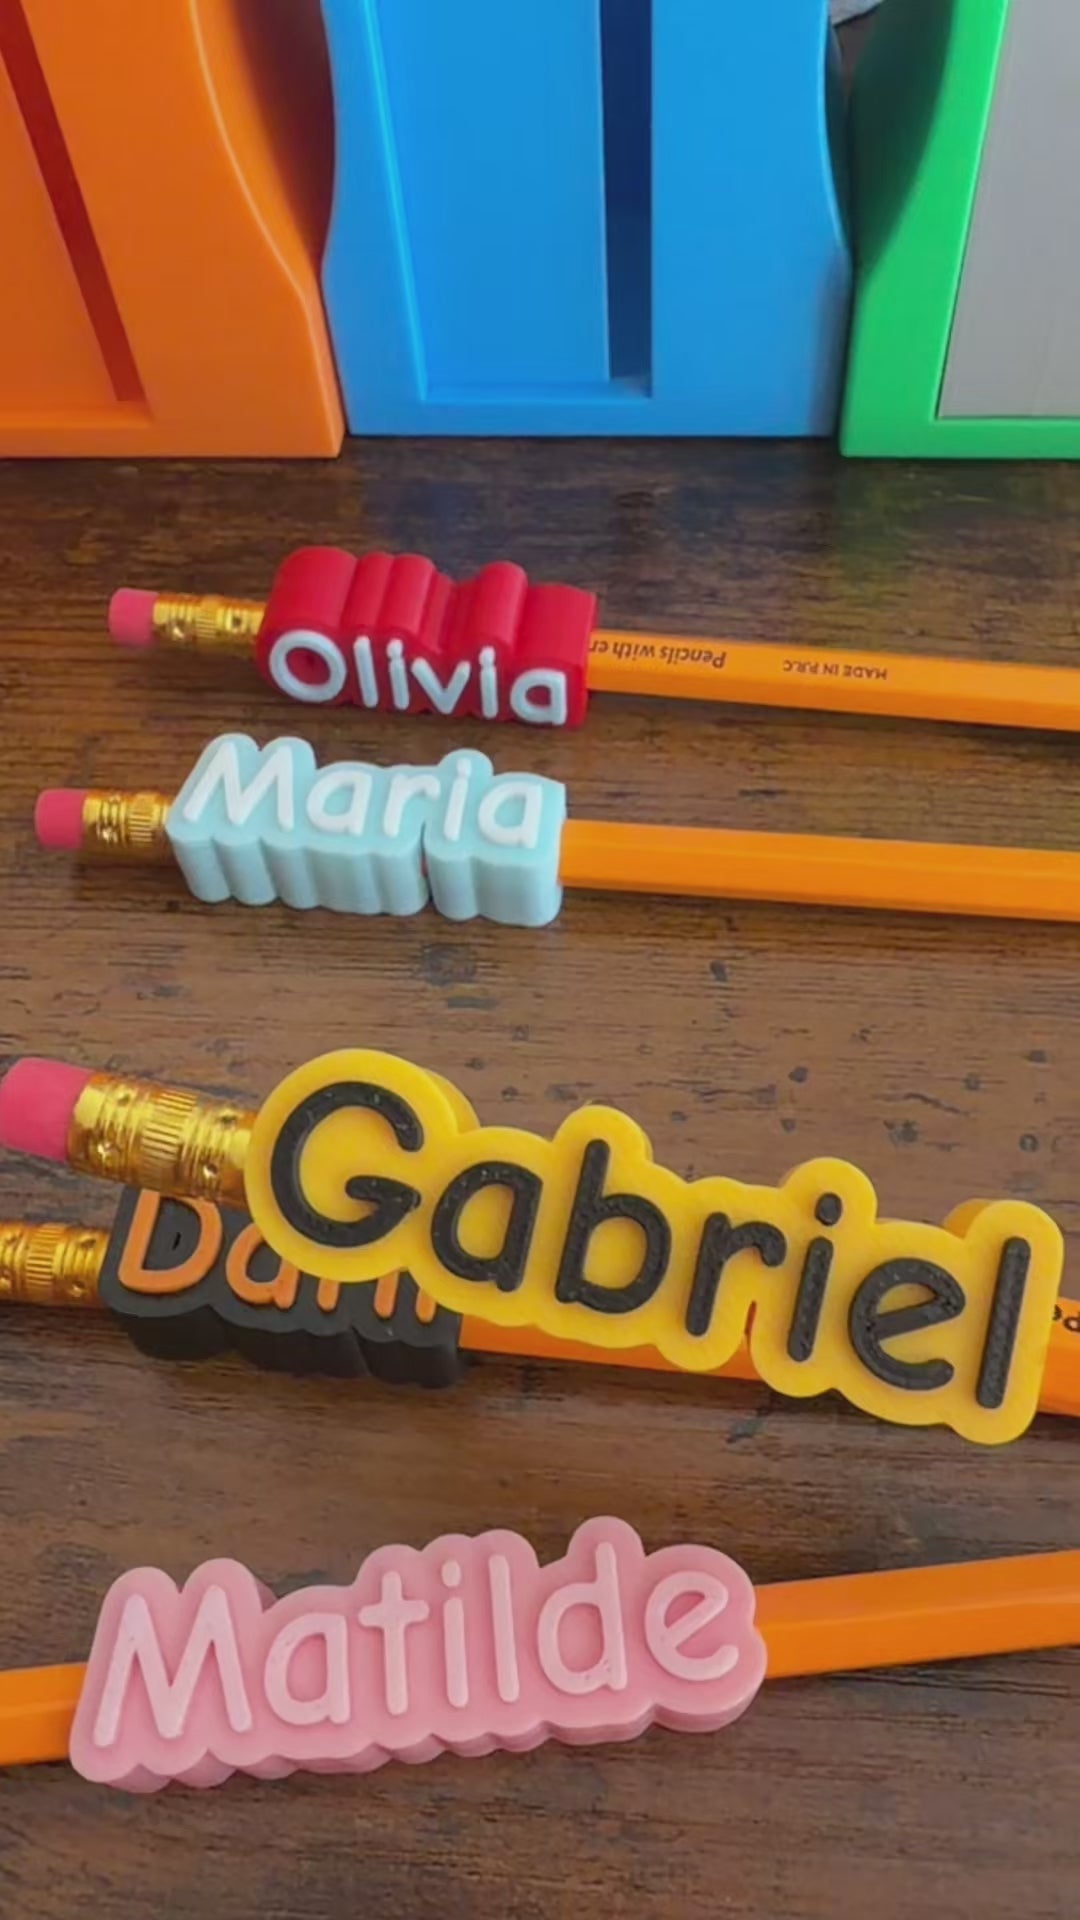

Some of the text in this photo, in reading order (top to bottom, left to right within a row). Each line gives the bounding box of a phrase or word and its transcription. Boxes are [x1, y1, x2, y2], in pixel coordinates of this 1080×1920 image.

[269, 629, 568, 725] Olivia
[612, 640, 655, 661] with
[659, 643, 727, 669] Pencils
[822, 664, 840, 676] IN
[843, 665, 887, 680] MADE
[183, 741, 544, 850] Maria
[270, 1081, 1031, 1408] Gabriel
[93, 1541, 739, 1747] Matilde
